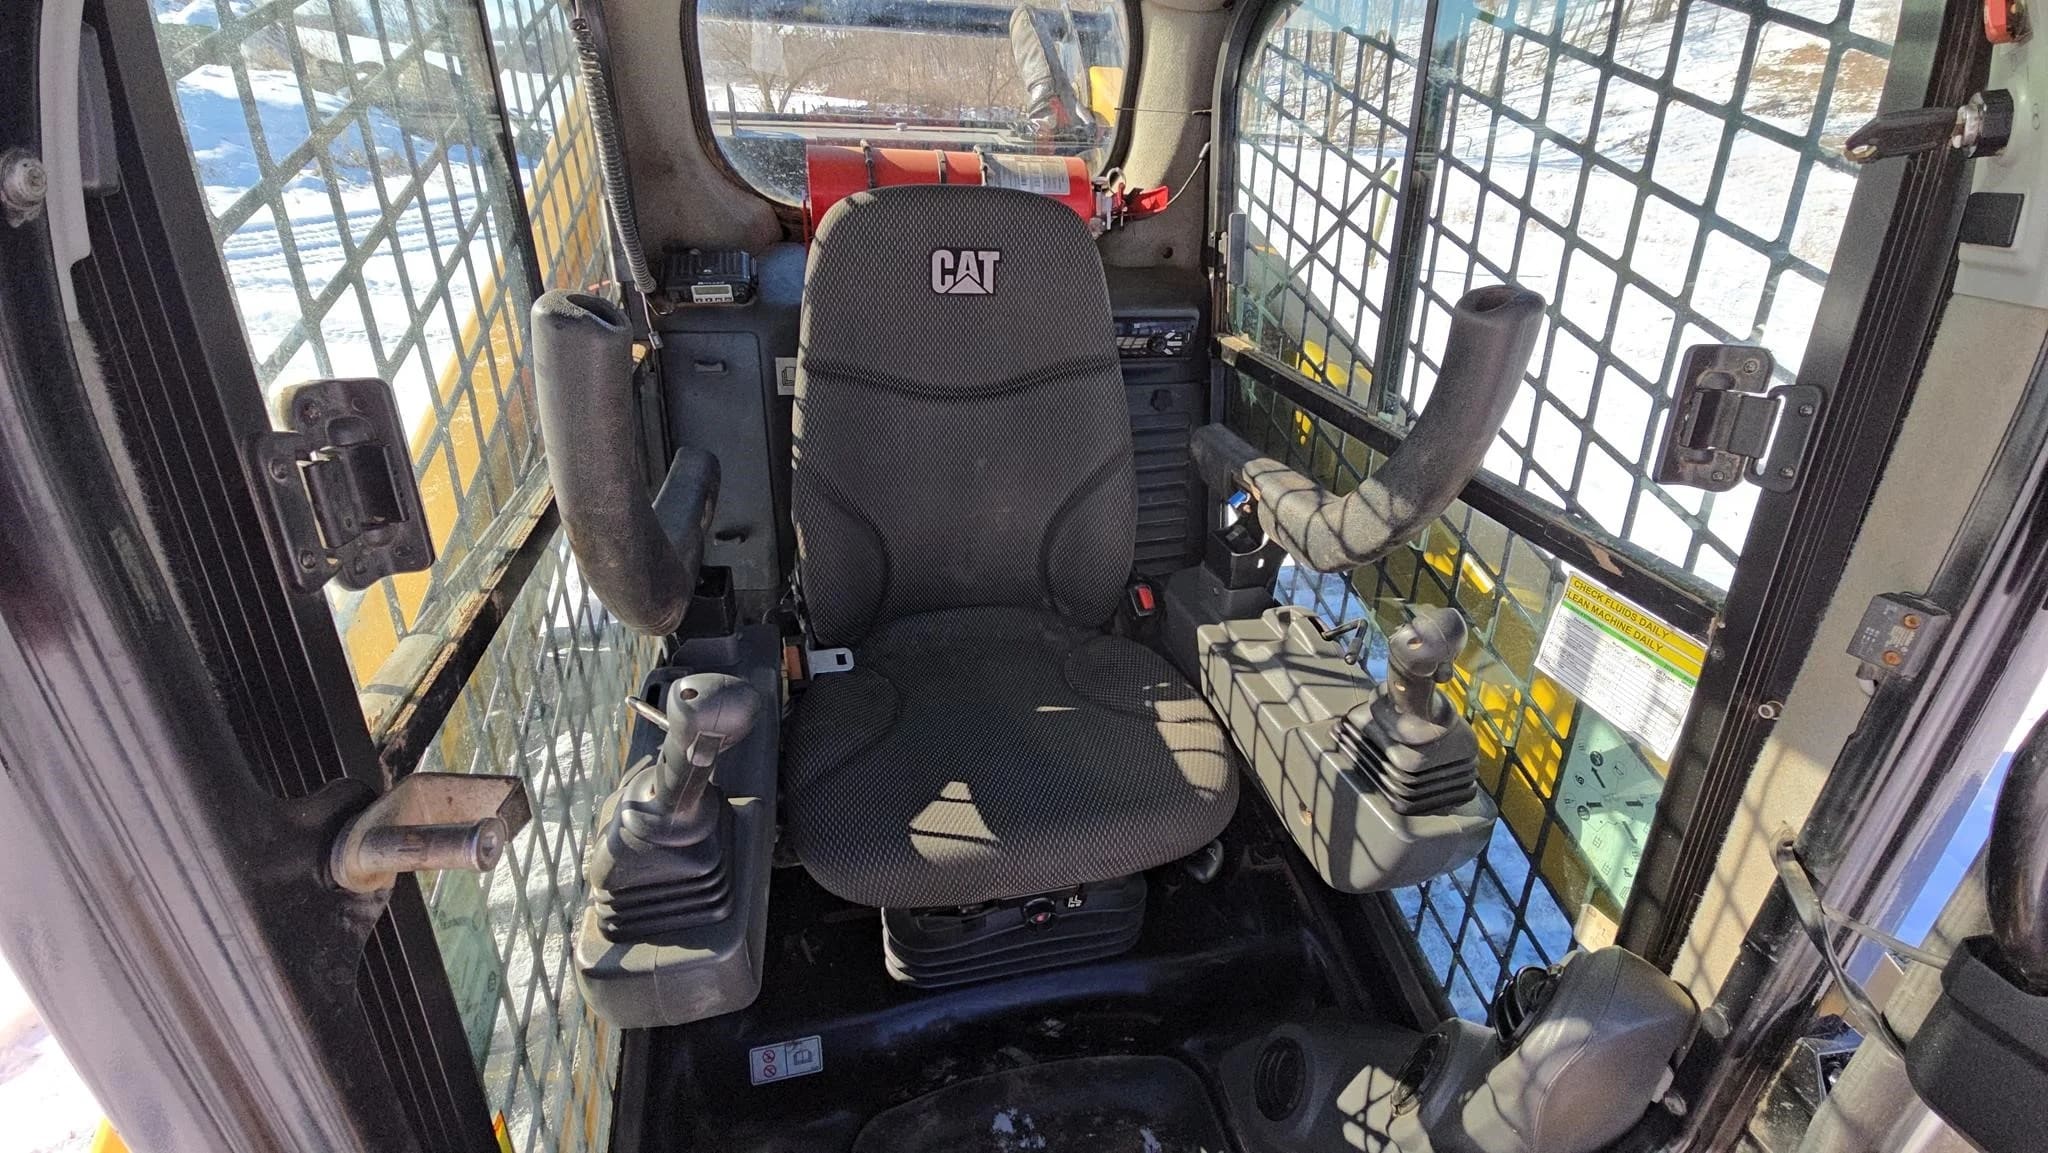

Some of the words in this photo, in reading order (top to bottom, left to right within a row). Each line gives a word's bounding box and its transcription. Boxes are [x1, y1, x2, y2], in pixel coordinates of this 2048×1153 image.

[932, 249, 1000, 294] CAT
[1574, 580, 1604, 601] CHECK
[1604, 598, 1638, 621] FLUIDS
[1638, 618, 1669, 638] DAILY
[1592, 604, 1633, 634] MACHINE
[1633, 631, 1664, 652] DAILY
